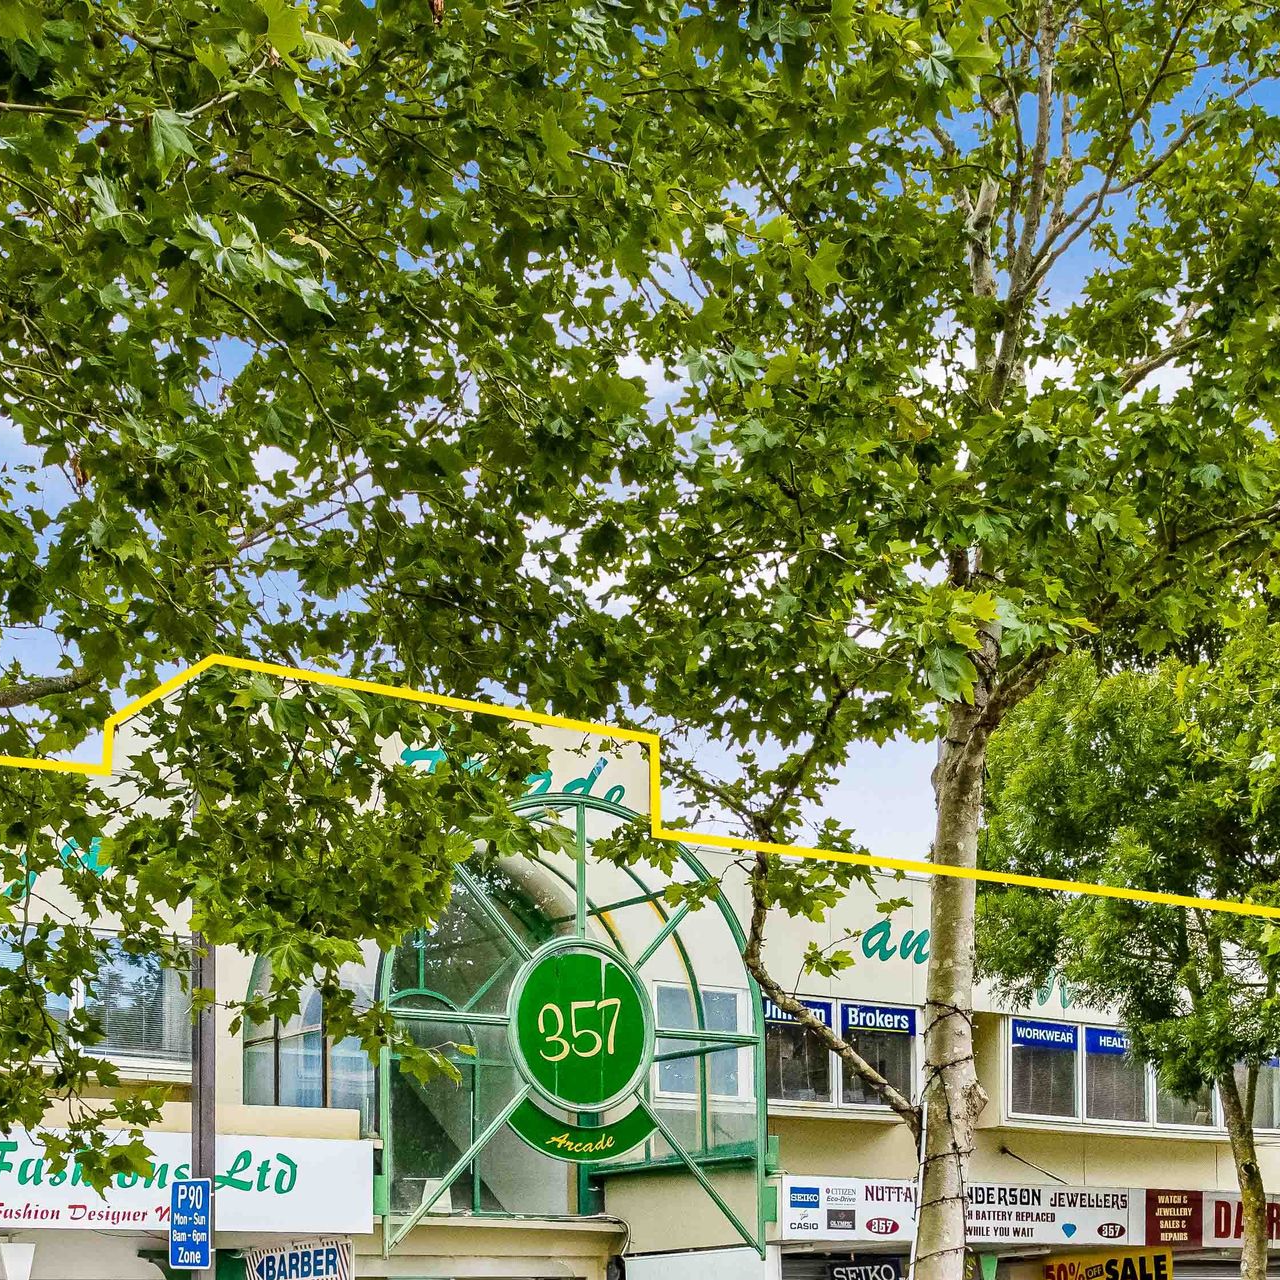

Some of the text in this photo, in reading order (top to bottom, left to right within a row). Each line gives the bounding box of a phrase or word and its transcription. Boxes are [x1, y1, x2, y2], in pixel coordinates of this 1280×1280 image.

[847, 1007, 910, 1029] Brokers
[537, 997, 622, 1062] 357
[1016, 1026, 1074, 1043] WORKWEAR
[1099, 1035, 1130, 1049] HEALT
[545, 1132, 616, 1153] Arcade
[214, 1149, 298, 1195] Ltd
[177, 1184, 203, 1209] P90
[790, 1193, 819, 1202] SEIKO
[826, 1195, 857, 1203] Eco-Drive
[831, 1188, 857, 1196] CITIZEN
[864, 1185, 1128, 1210] NUTTA NDERSON JEWELLERS
[1158, 1195, 1182, 1204] WATCH
[67, 1204, 149, 1225] Designer
[173, 1212, 188, 1225] Mon
[193, 1213, 206, 1226] Sun
[975, 1210, 1012, 1221] BATTERY
[1016, 1212, 1056, 1222] REPLACED
[1155, 1208, 1192, 1217] JEWELLERY
[789, 1222, 819, 1230] CASIO
[871, 1219, 895, 1233] 357
[1101, 1224, 1121, 1236] 357
[1160, 1220, 1180, 1229] SALES
[172, 1229, 207, 1244] 8am 6pm
[966, 1226, 1035, 1238] WHILE YOU WAIT
[1160, 1232, 1188, 1241] REPAIRS
[178, 1247, 202, 1264] Zone
[1086, 1264, 1103, 1278] OFF
